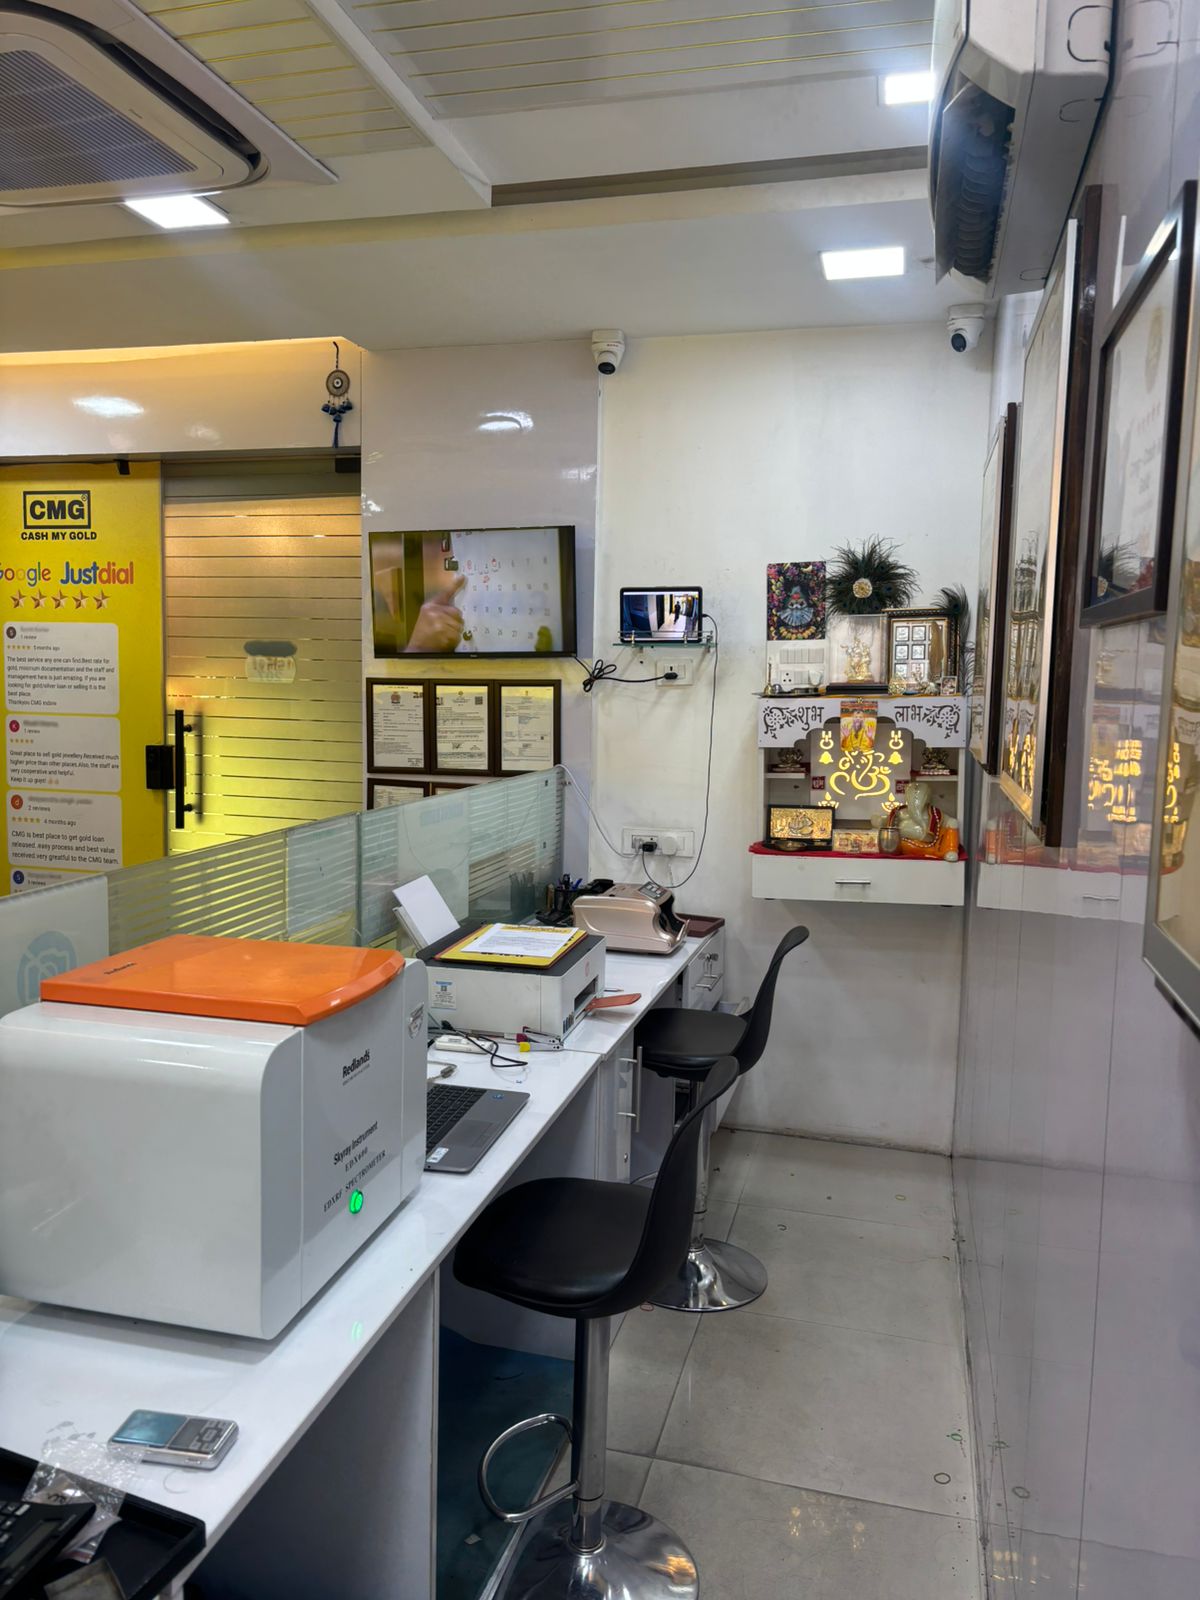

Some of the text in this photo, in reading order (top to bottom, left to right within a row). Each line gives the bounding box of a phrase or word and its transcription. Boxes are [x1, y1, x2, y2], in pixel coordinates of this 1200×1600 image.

[29, 499, 85, 521] CMG
[20, 531, 97, 541] CASH MY GOLD
[59, 561, 134, 585] Justdial
[44, 657, 53, 665] any
[797, 705, 923, 731] शुभ लाभ
[67, 820, 77, 828] ago
[11, 830, 26, 838] CMG
[45, 833, 61, 841] place
[68, 835, 78, 843] get
[78, 834, 92, 843] gold
[51, 844, 74, 852] process
[36, 854, 49, 862] very
[48, 854, 71, 862] greatful
[77, 855, 88, 863] the
[87, 856, 103, 864] CMG
[342, 1048, 371, 1079] Redlands
[333, 1120, 378, 1166] Skyray Instrument
[344, 1149, 387, 1192] SPECTROMETER
